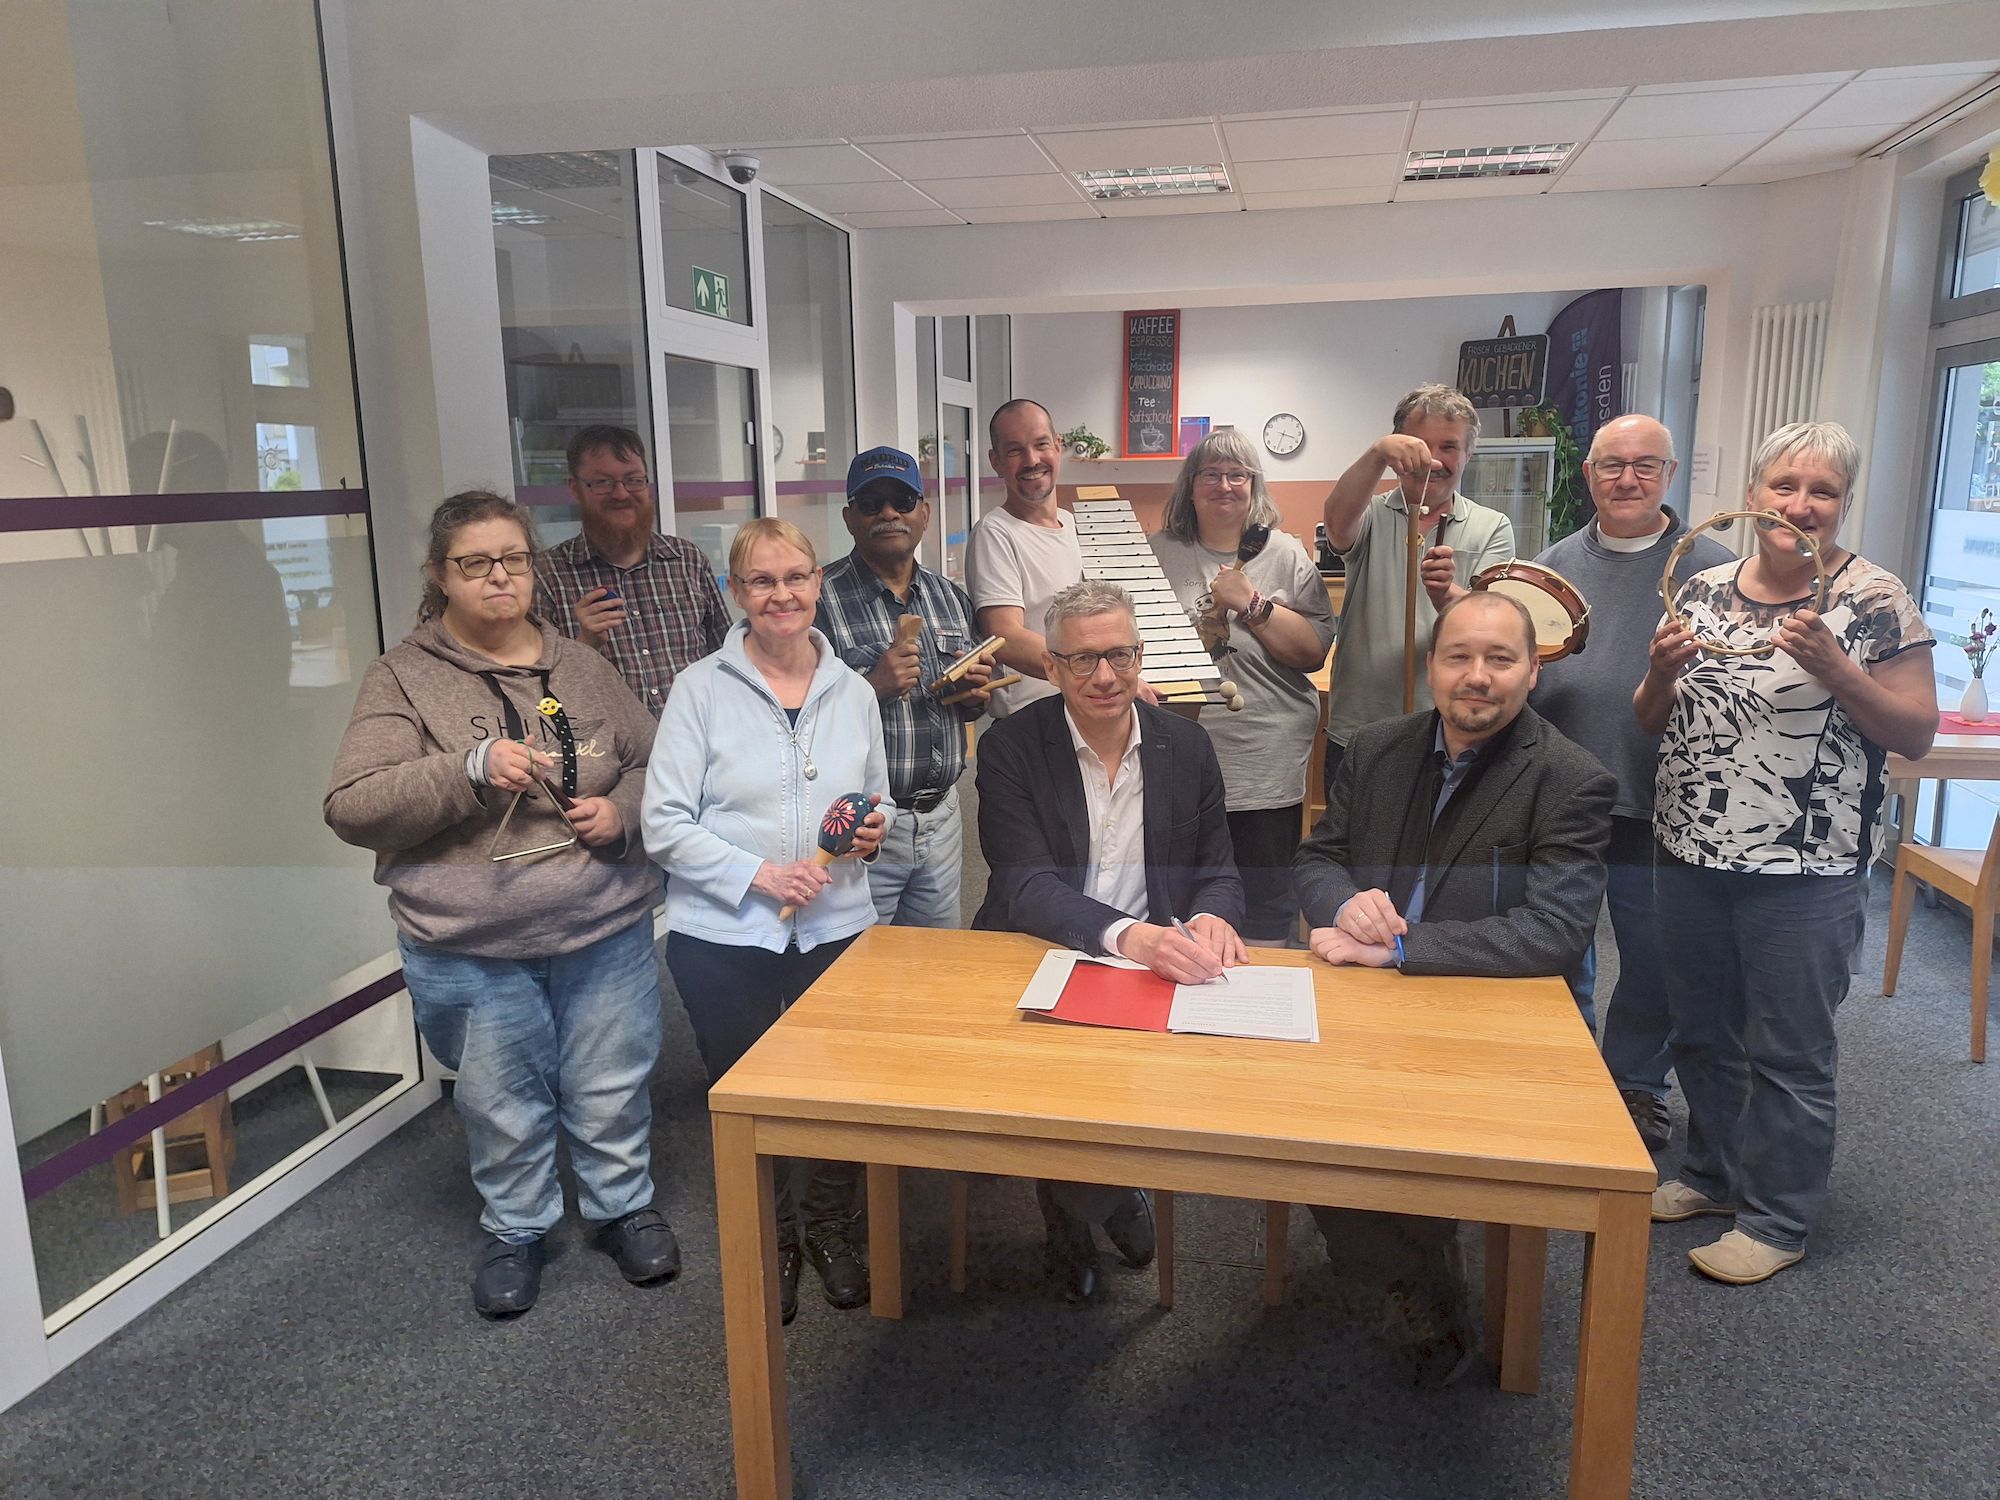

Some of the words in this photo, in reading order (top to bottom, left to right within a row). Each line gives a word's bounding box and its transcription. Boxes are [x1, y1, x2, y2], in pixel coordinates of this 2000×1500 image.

[1130, 316, 1174, 334] KAFFEE
[1129, 335, 1174, 347] ESPRESSO
[1468, 345, 1490, 355] FRISCH
[1460, 351, 1537, 394] KUCHEN
[1569, 352, 1590, 444] iakonie
[1595, 365, 1612, 423] sden
[1138, 397, 1156, 407] Tee
[1184, 578, 1206, 590] Sorry
